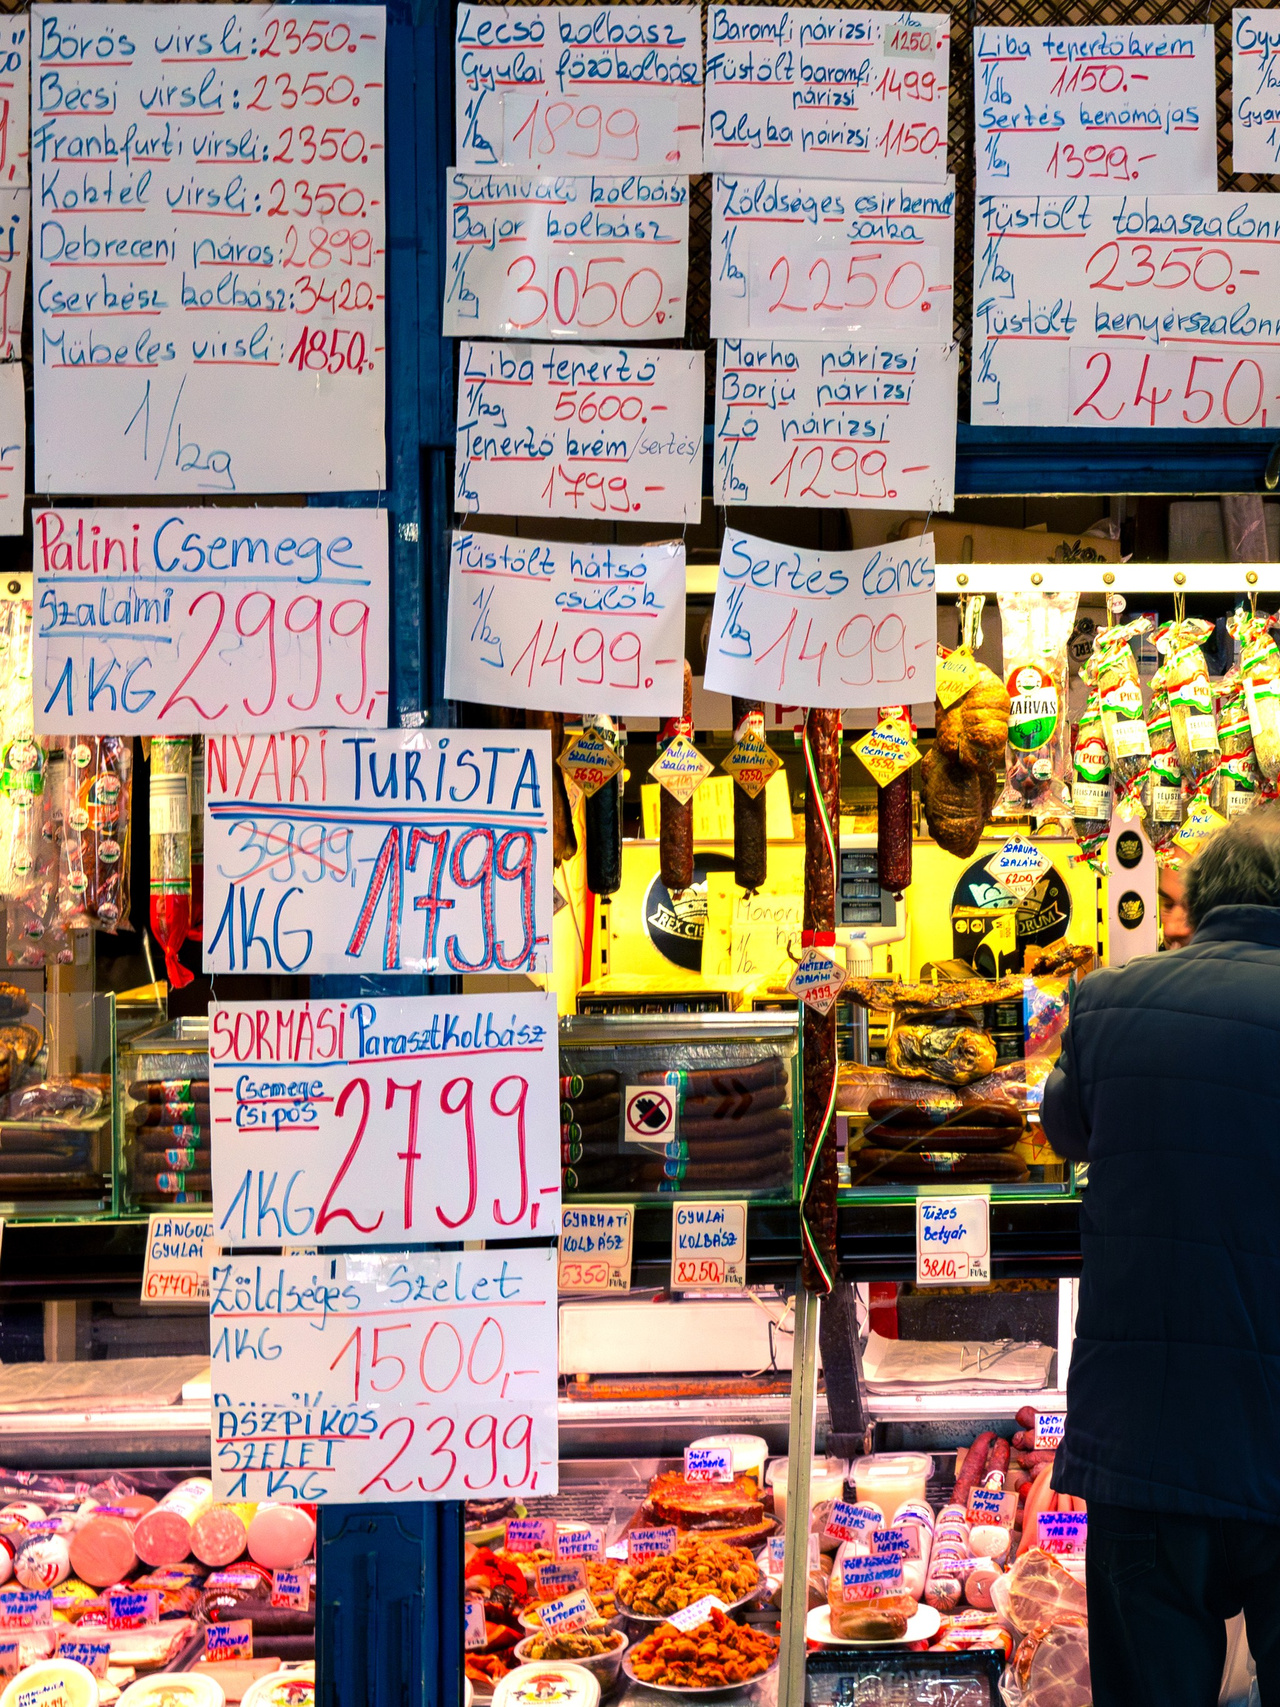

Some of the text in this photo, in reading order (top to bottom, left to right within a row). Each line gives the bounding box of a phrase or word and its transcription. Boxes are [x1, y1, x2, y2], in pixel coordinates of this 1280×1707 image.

[713, 8, 793, 42] Baromfi
[977, 33, 1032, 57] Liba
[461, 52, 545, 90] Gyulai
[706, 50, 795, 82] Füstölt
[711, 110, 793, 149] Pulyka
[453, 206, 522, 250] Bajor
[980, 196, 1092, 229] Füstölt
[977, 299, 1078, 334] Füstölt
[464, 349, 534, 382] Liba
[723, 340, 799, 366] Marha
[154, 518, 363, 584] Csemege
[454, 539, 555, 573] Füstölt
[1120, 692, 1141, 702] PICK
[1082, 754, 1106, 765] PICK
[659, 911, 681, 932] REX
